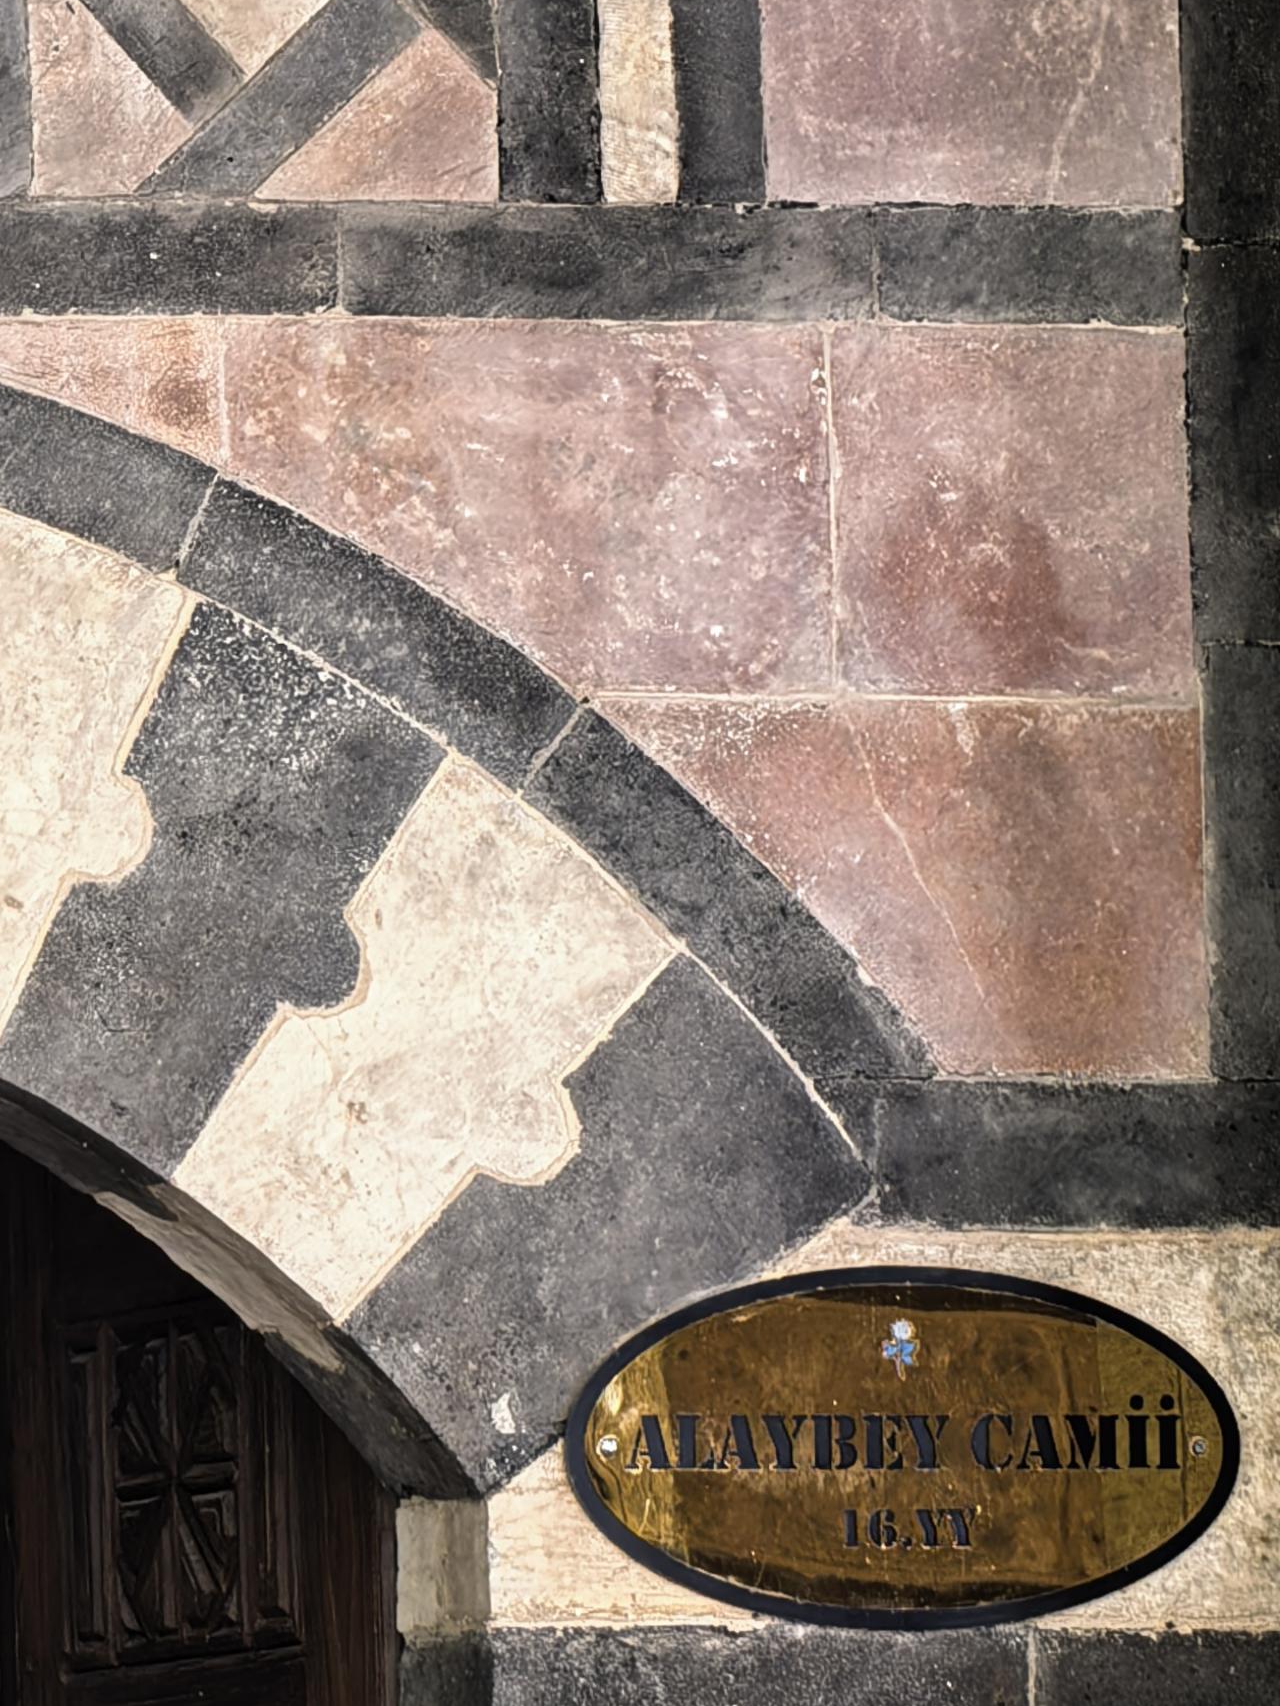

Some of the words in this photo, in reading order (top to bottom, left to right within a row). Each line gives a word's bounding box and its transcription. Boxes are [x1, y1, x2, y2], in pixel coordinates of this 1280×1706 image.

[625, 1414, 949, 1471] ALAYBEY
[971, 1394, 1181, 1471] CAMİİ
[843, 1509, 977, 1549] 16.YY
